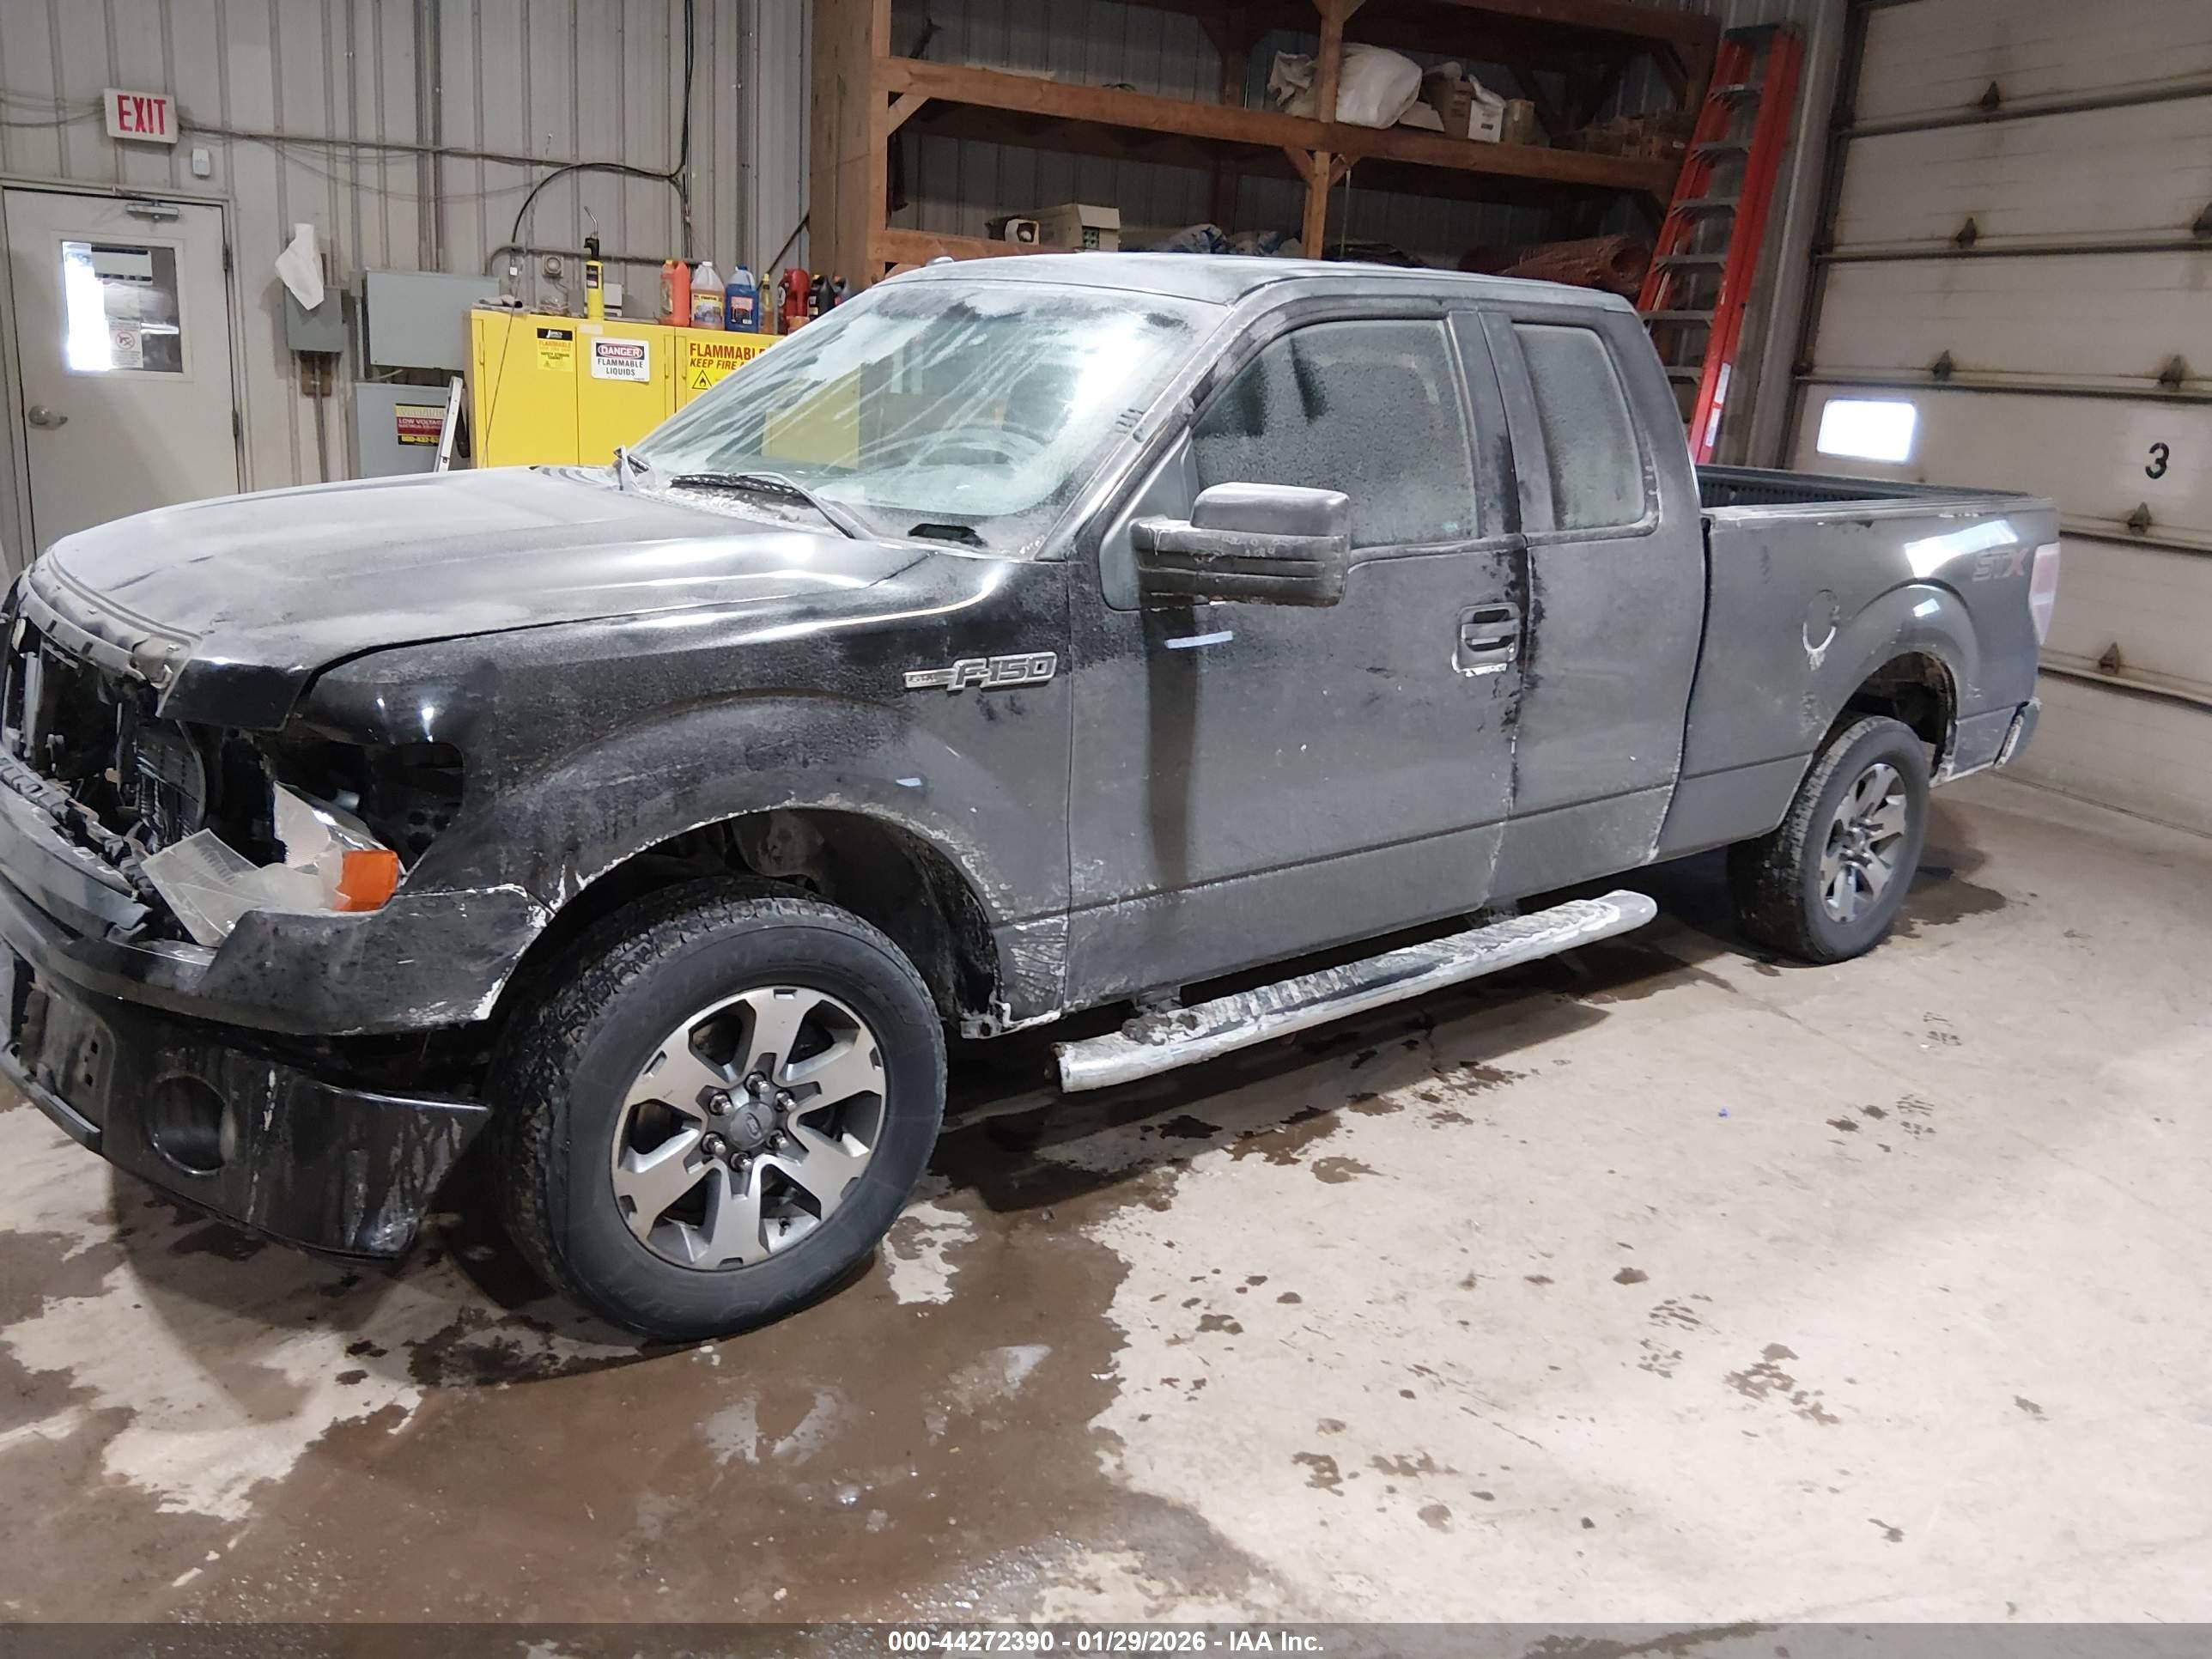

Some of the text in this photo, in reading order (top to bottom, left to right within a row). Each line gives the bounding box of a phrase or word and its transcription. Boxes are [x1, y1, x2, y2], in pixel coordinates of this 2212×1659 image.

[117, 94, 167, 135] EXIT
[597, 358, 643, 368] FLAMMABLE
[601, 346, 640, 357] DANGER
[605, 368, 635, 376] LIQUIDS
[690, 357, 714, 368] KEEP
[716, 359, 738, 370] FIRE
[2145, 442, 2170, 479] 3
[1972, 548, 2030, 582] STX
[947, 651, 1058, 690] F-150
